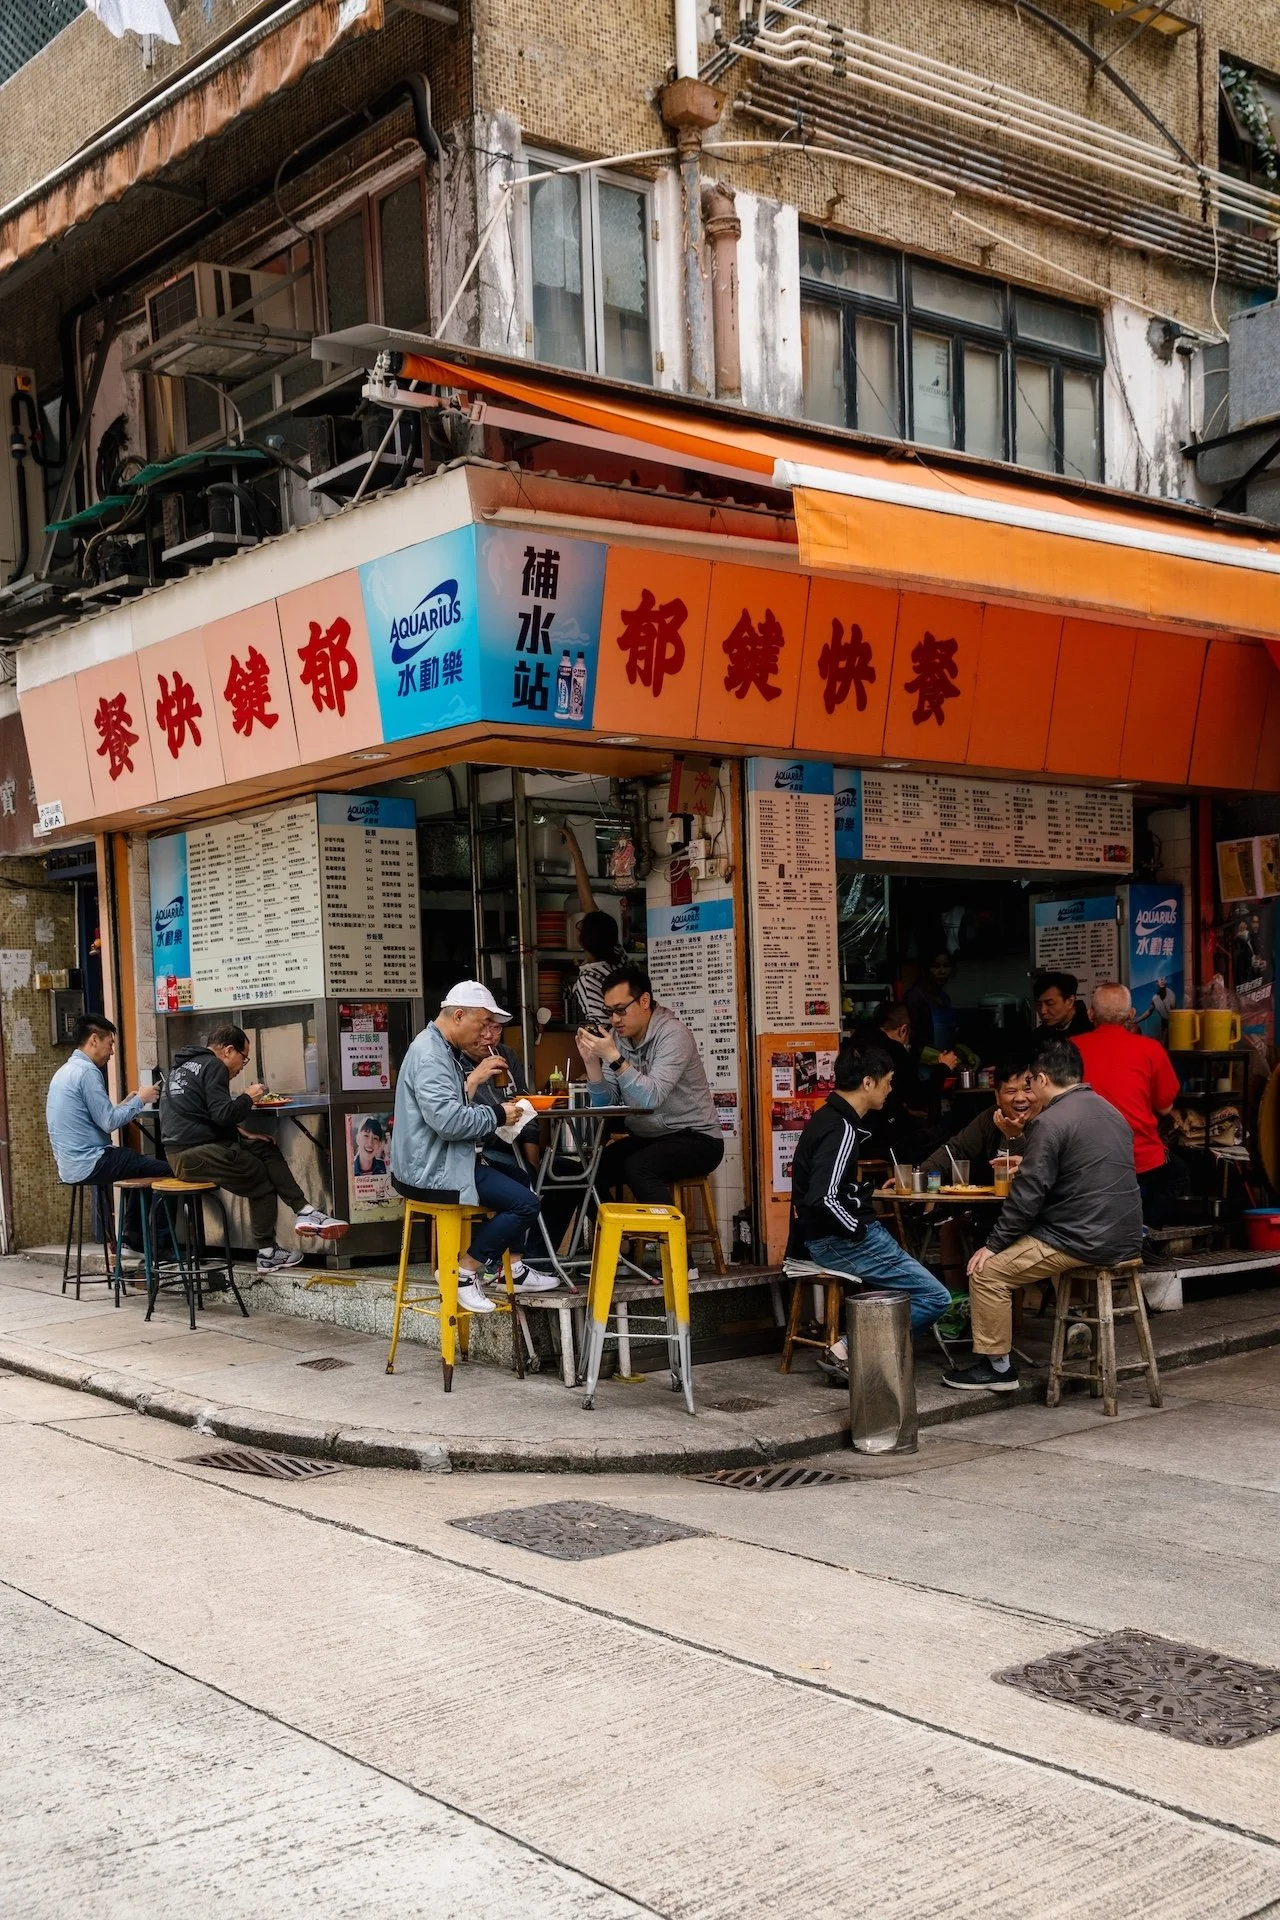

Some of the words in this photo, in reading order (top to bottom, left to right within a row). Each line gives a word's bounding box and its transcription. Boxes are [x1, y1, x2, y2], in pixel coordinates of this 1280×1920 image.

[389, 598, 462, 644] AQUARIUS
[512, 545, 561, 711] 補水站
[397, 648, 464, 697] 水動樂
[774, 769, 804, 781] AQUARIUS
[155, 903, 185, 923] AQUARIUS
[671, 910, 700, 925] AQUARIUS
[1135, 909, 1178, 925] AQUARIUS
[156, 928, 183, 948] 水動樂
[1135, 936, 1174, 957] 水動樂
